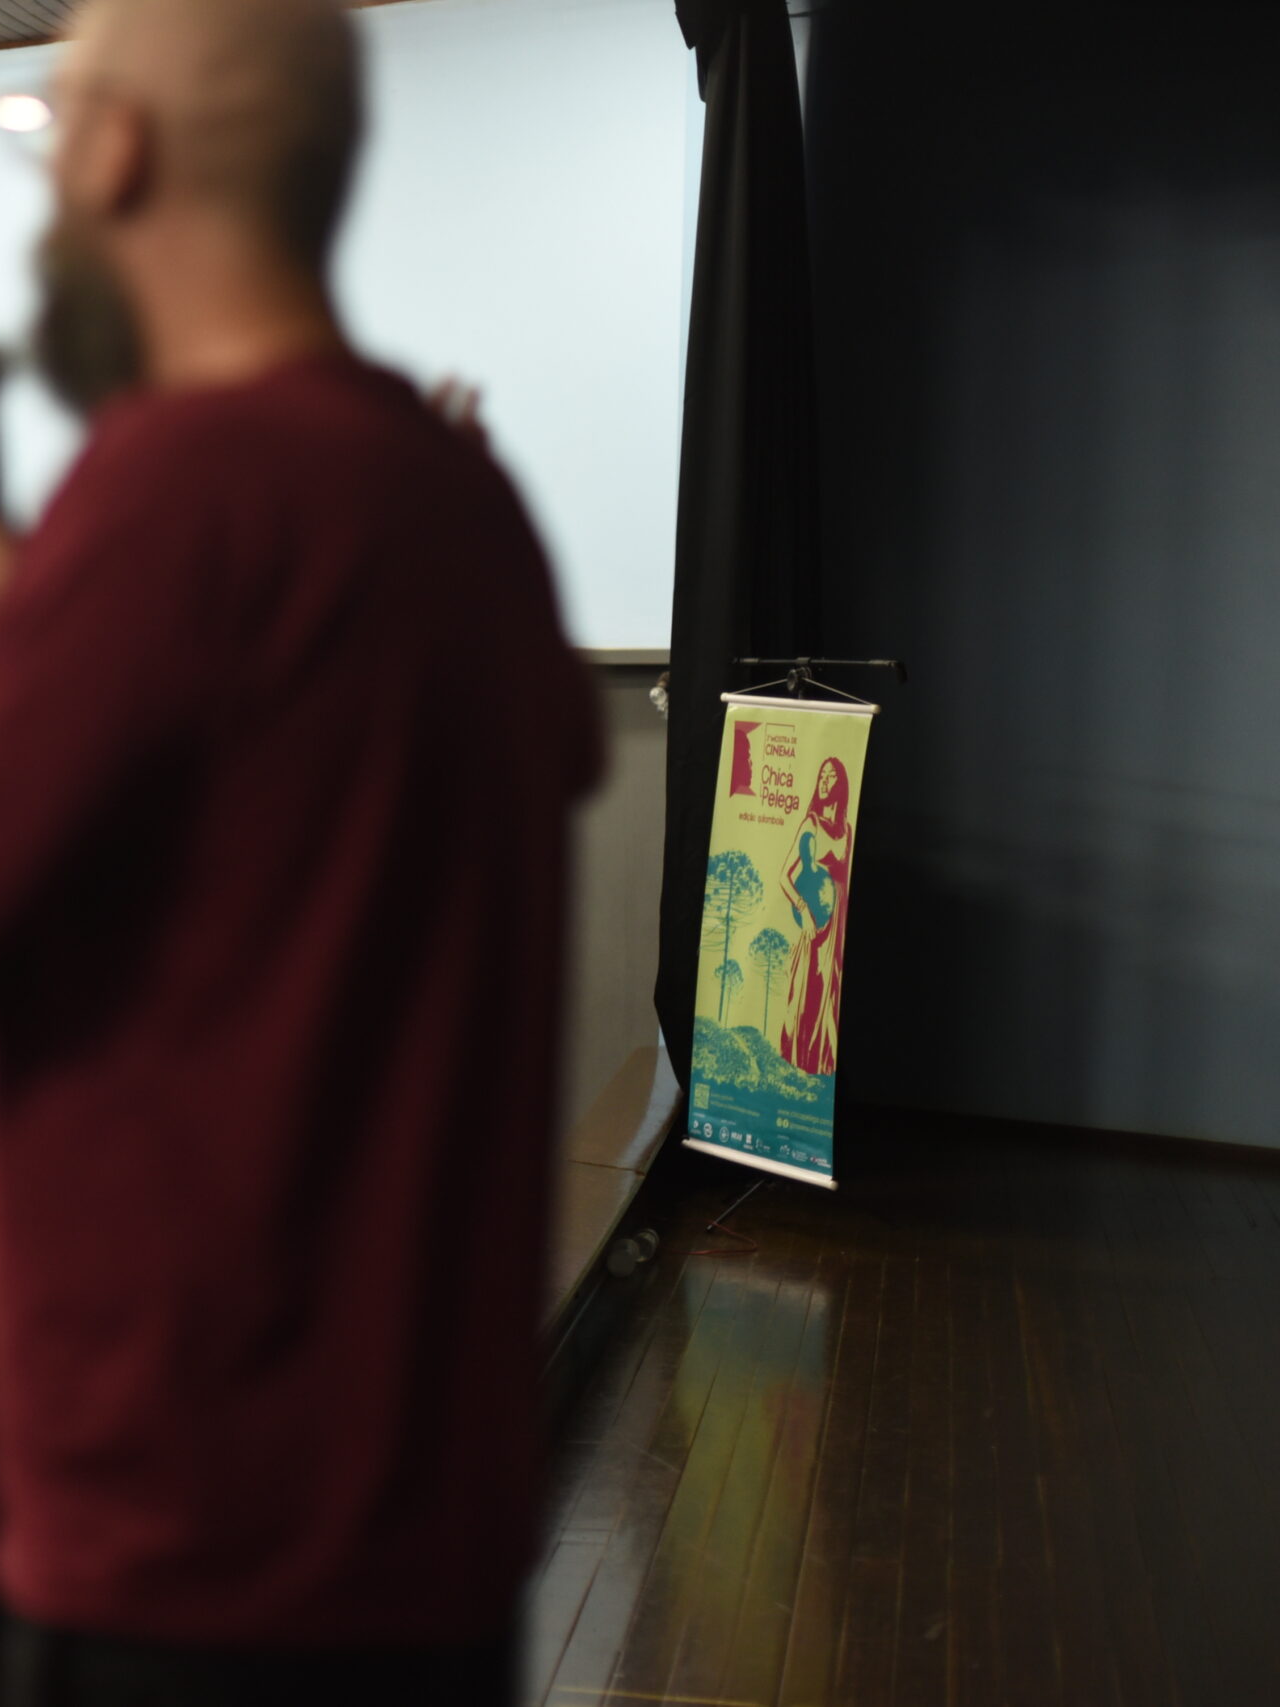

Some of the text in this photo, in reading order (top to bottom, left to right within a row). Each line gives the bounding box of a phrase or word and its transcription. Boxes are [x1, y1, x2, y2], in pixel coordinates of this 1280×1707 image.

[765, 744, 795, 757] CINEMA
[761, 764, 793, 787] Chica
[762, 786, 799, 814] Pelega
